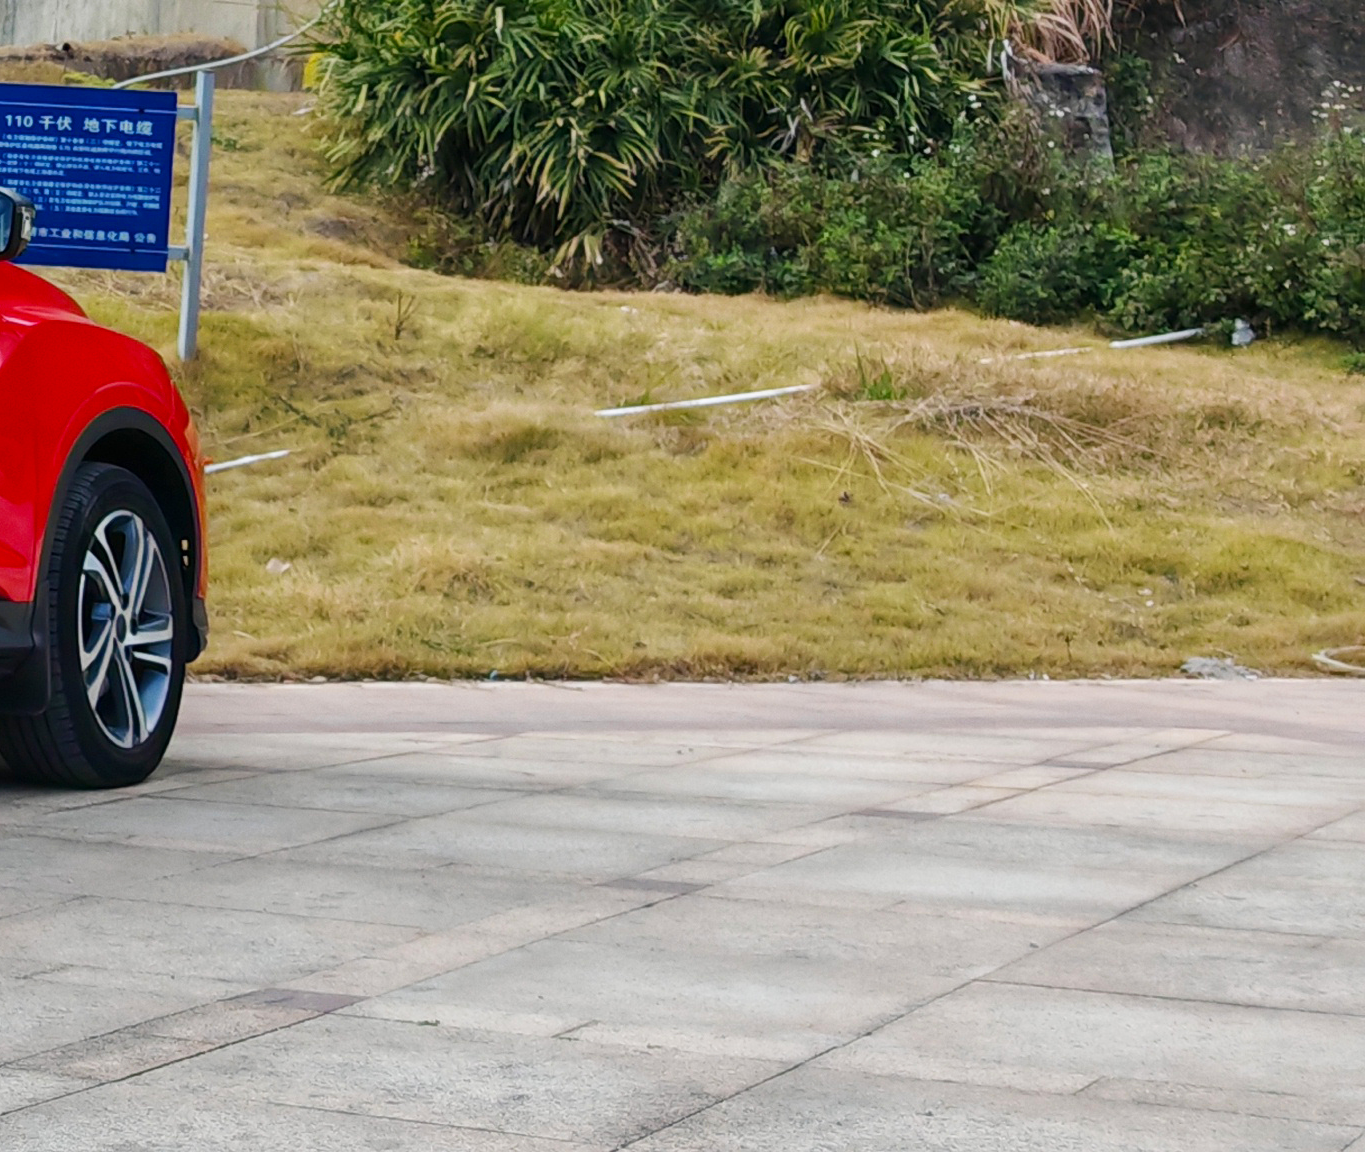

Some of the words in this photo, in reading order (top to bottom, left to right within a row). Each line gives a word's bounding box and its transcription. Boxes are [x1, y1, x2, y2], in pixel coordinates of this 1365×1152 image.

[5, 114, 33, 127] 110
[39, 115, 72, 131] 千伏
[83, 117, 153, 136] 地下电缆
